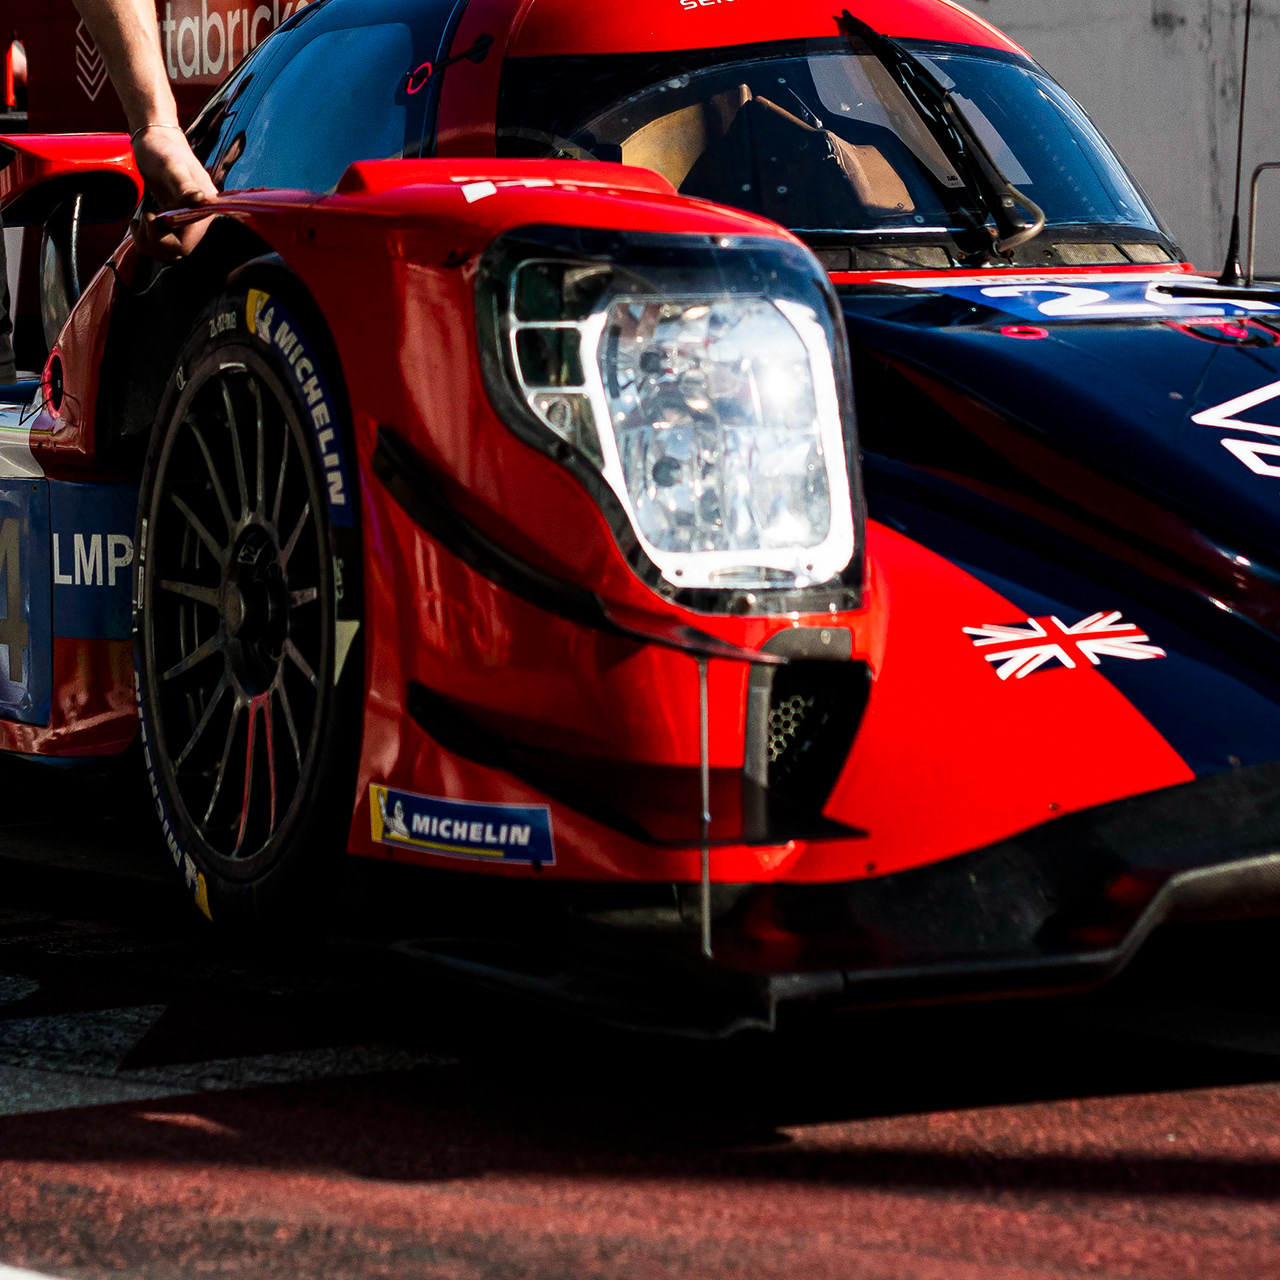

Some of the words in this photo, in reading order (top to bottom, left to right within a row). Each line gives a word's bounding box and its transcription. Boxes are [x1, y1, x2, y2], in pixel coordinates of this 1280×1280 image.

[273, 321, 347, 506] MICHELIN
[53, 533, 134, 586] LMP
[412, 812, 531, 846] MICHELIN
